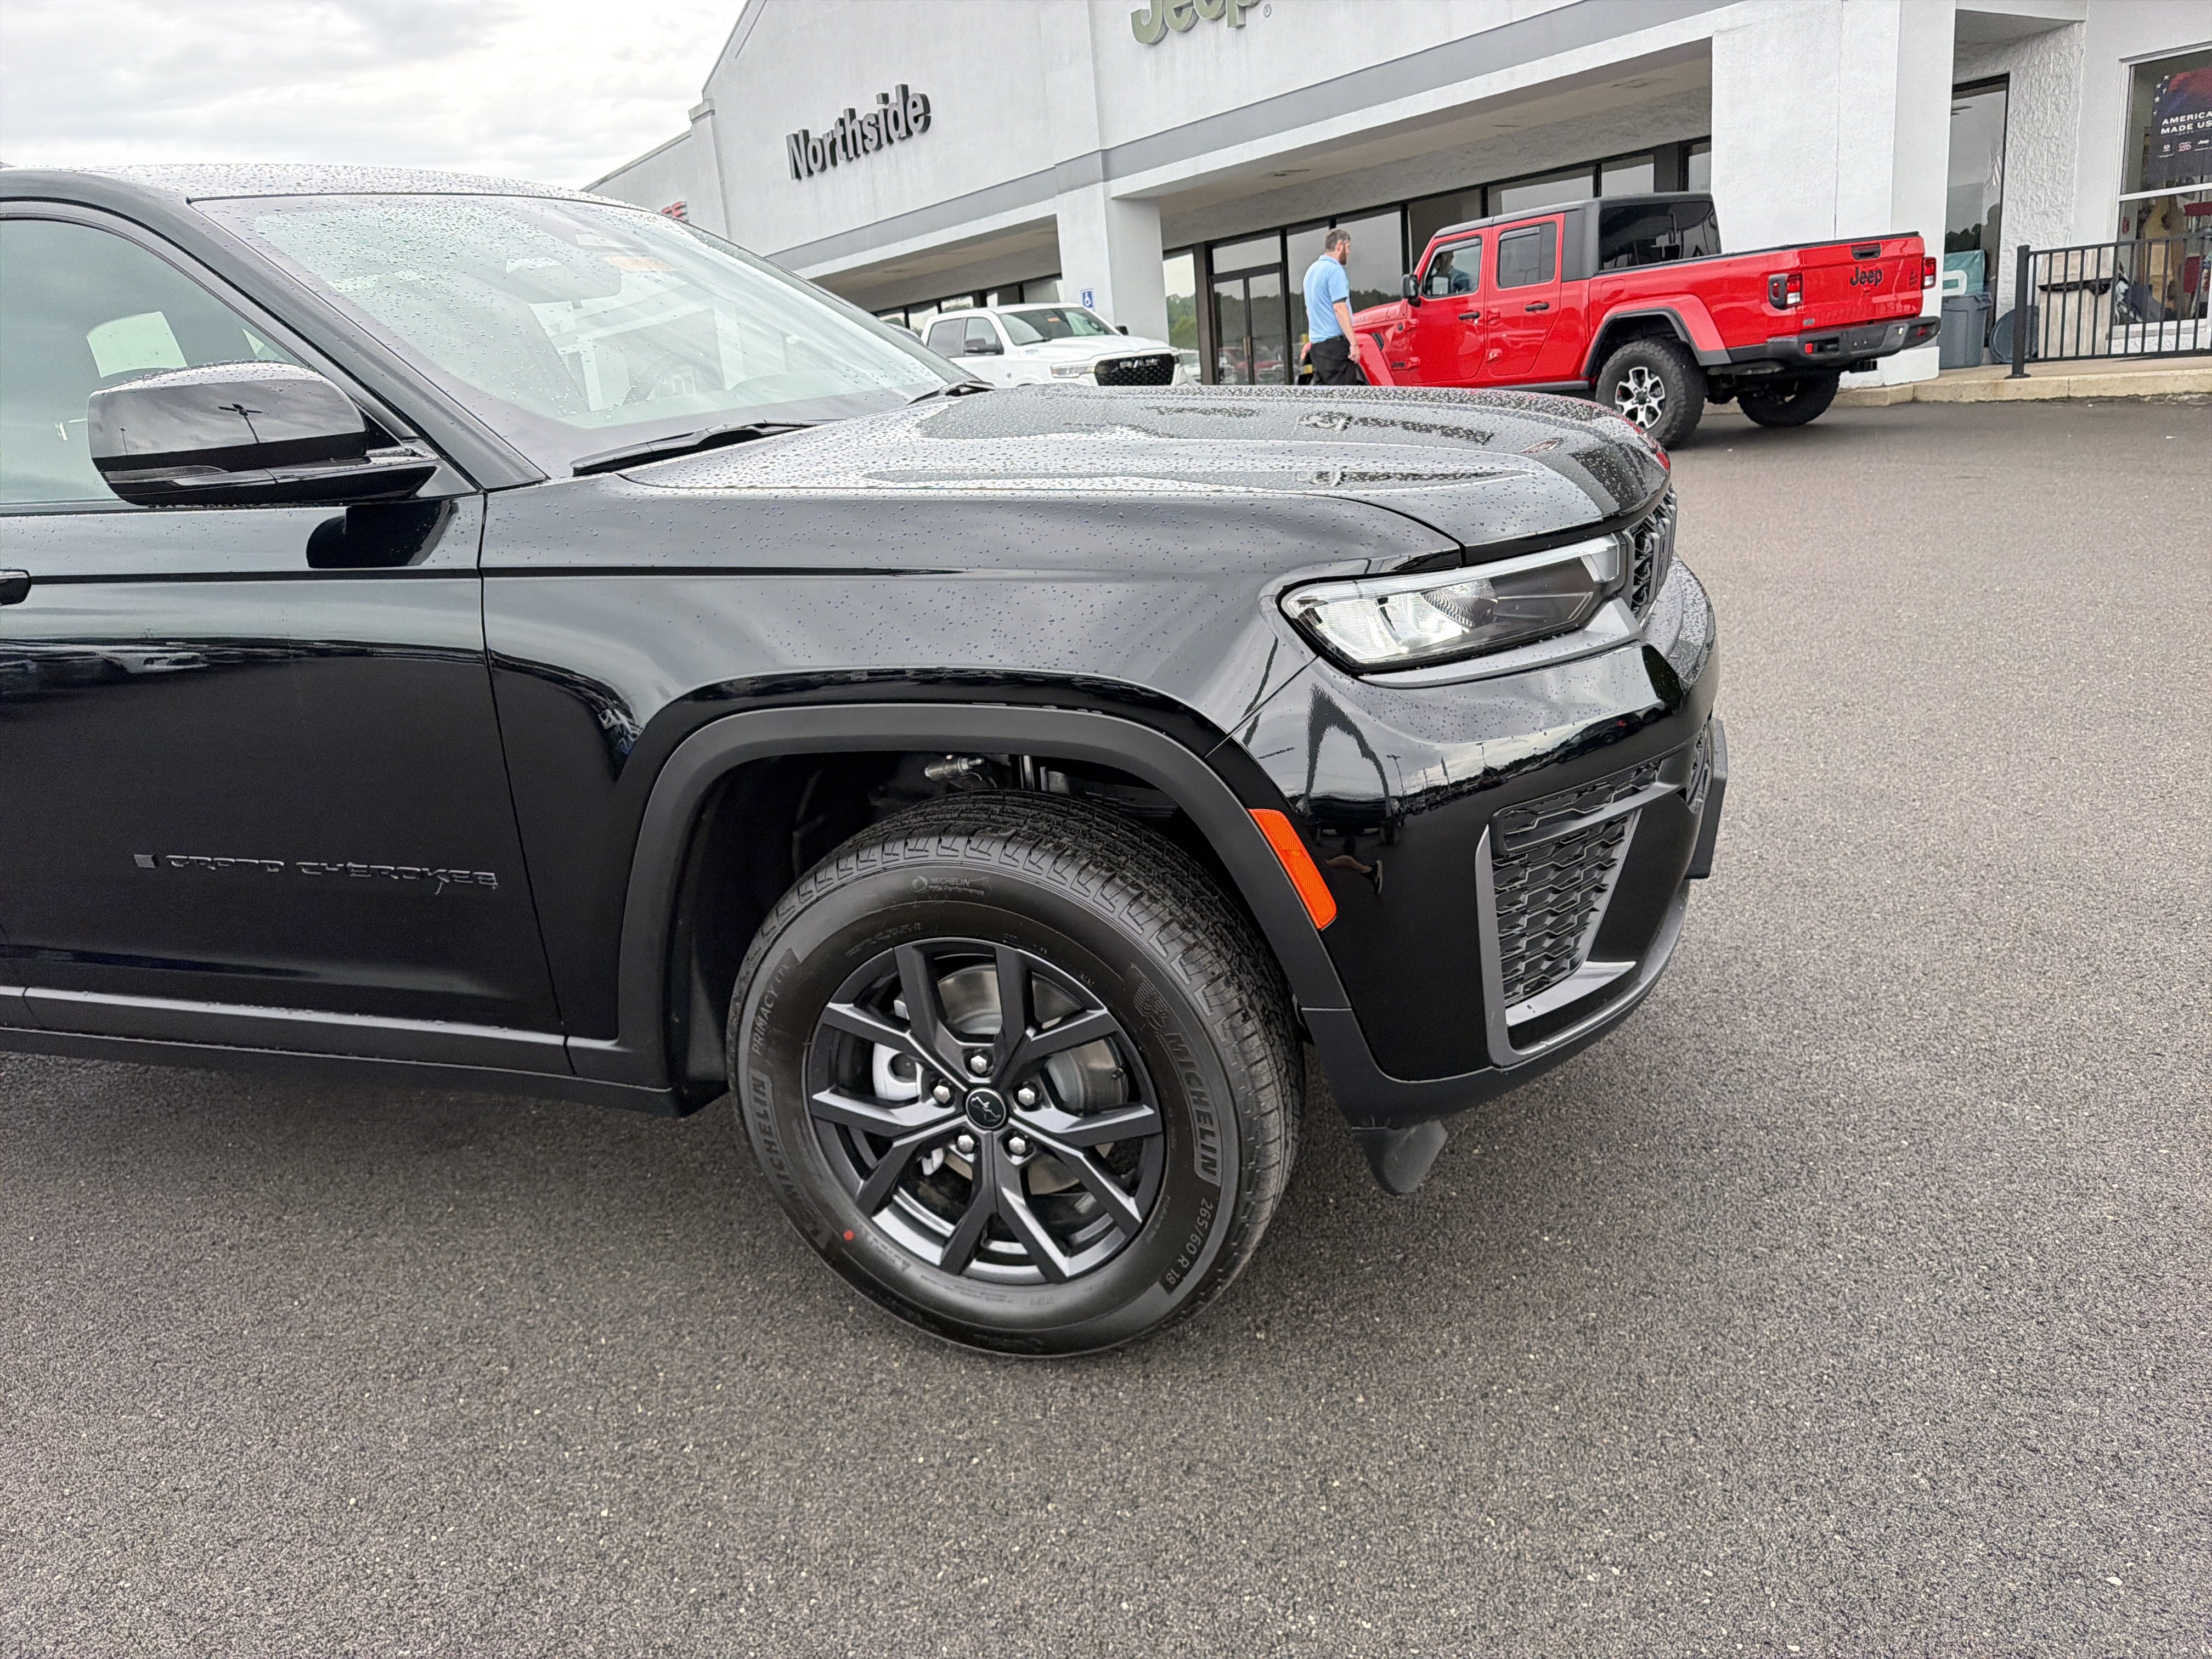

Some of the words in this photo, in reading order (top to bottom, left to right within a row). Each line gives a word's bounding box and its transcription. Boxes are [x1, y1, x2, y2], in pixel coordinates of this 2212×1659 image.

[786, 83, 932, 180] Northside
[2161, 123, 2193, 134] MADE
[1850, 267, 1883, 287] Jeep
[930, 878, 970, 887] MICHELIN
[752, 985, 778, 1056] PRIMACY
[1164, 1032, 1217, 1176] MICHELIN
[1186, 1198, 1213, 1255] 265/60
[1177, 1255, 1190, 1268] R
[1166, 1268, 1180, 1285] 18
